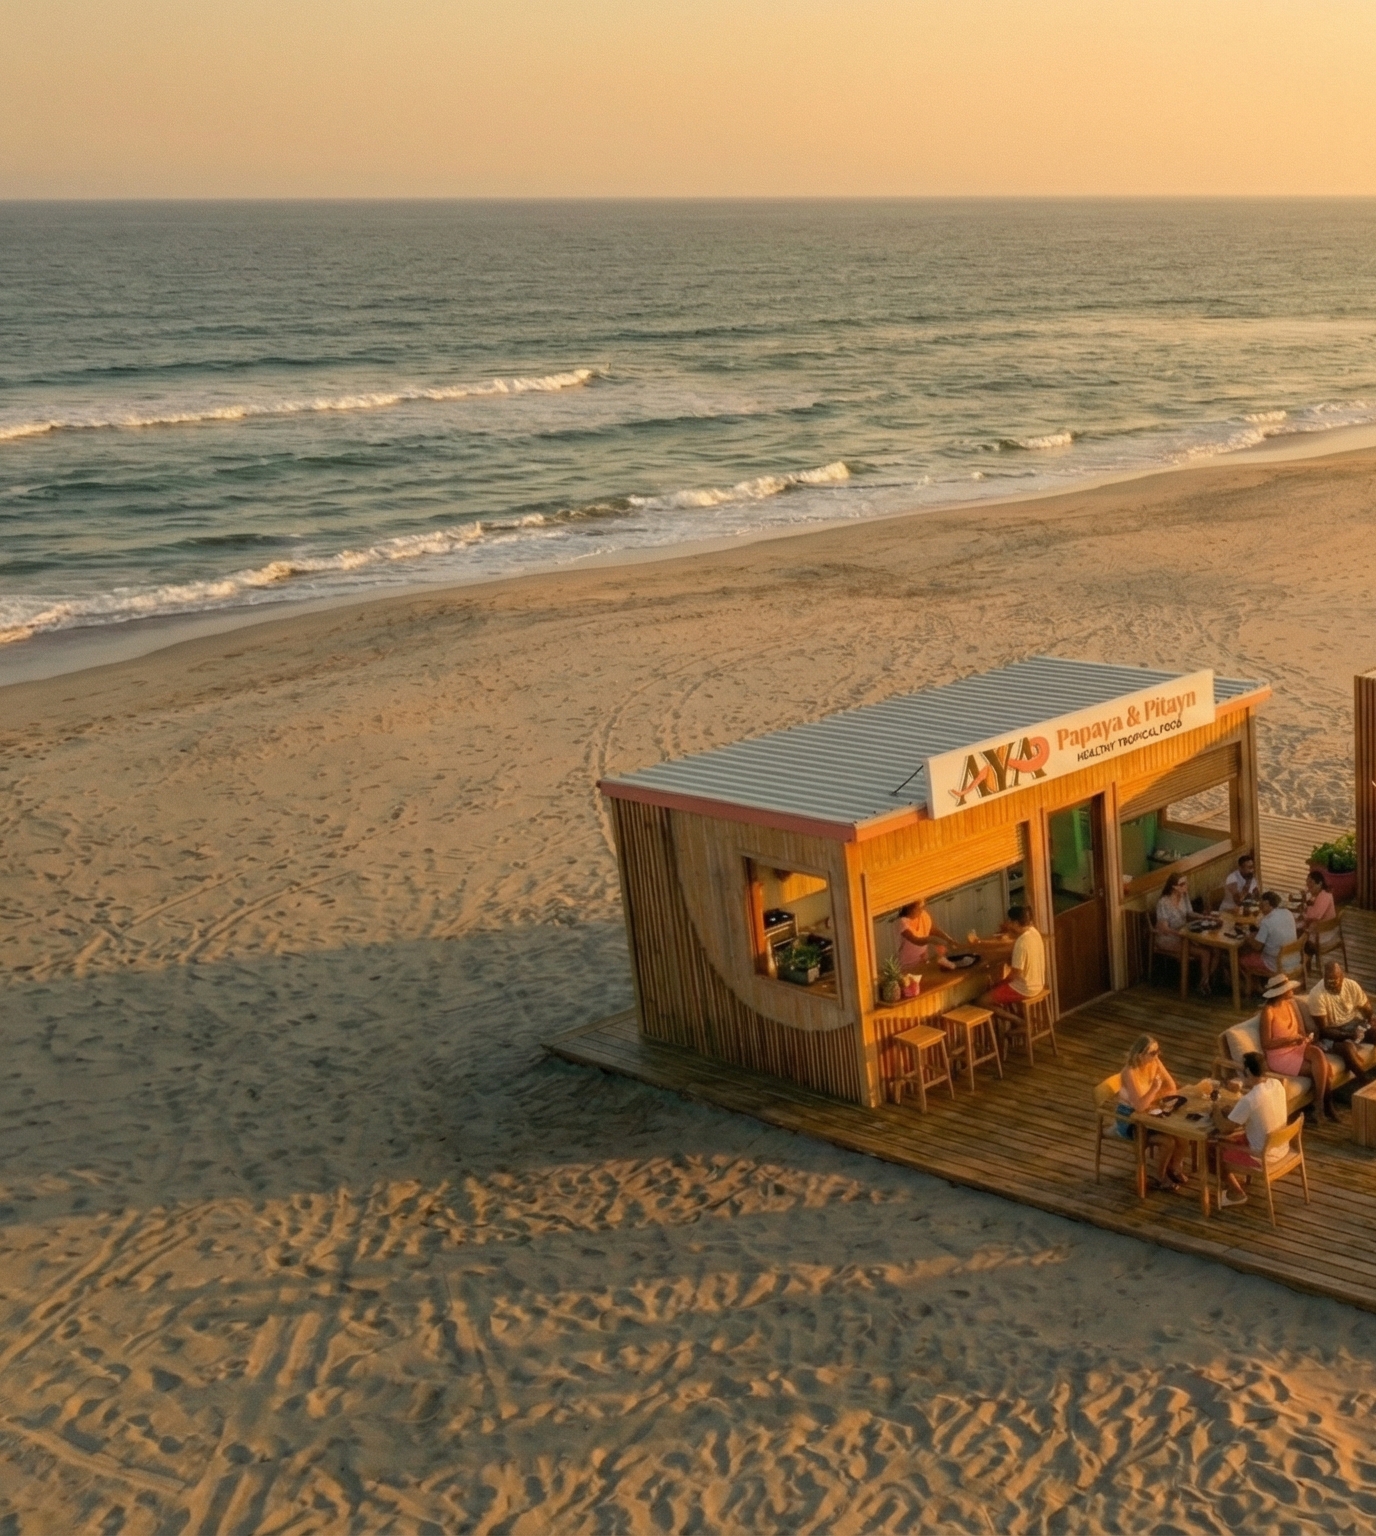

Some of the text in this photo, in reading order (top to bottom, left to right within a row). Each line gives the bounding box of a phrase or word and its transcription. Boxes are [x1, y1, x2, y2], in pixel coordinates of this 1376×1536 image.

[1057, 715, 1123, 751] Papaya
[1126, 706, 1141, 727] &
[948, 737, 1050, 807] AYA
